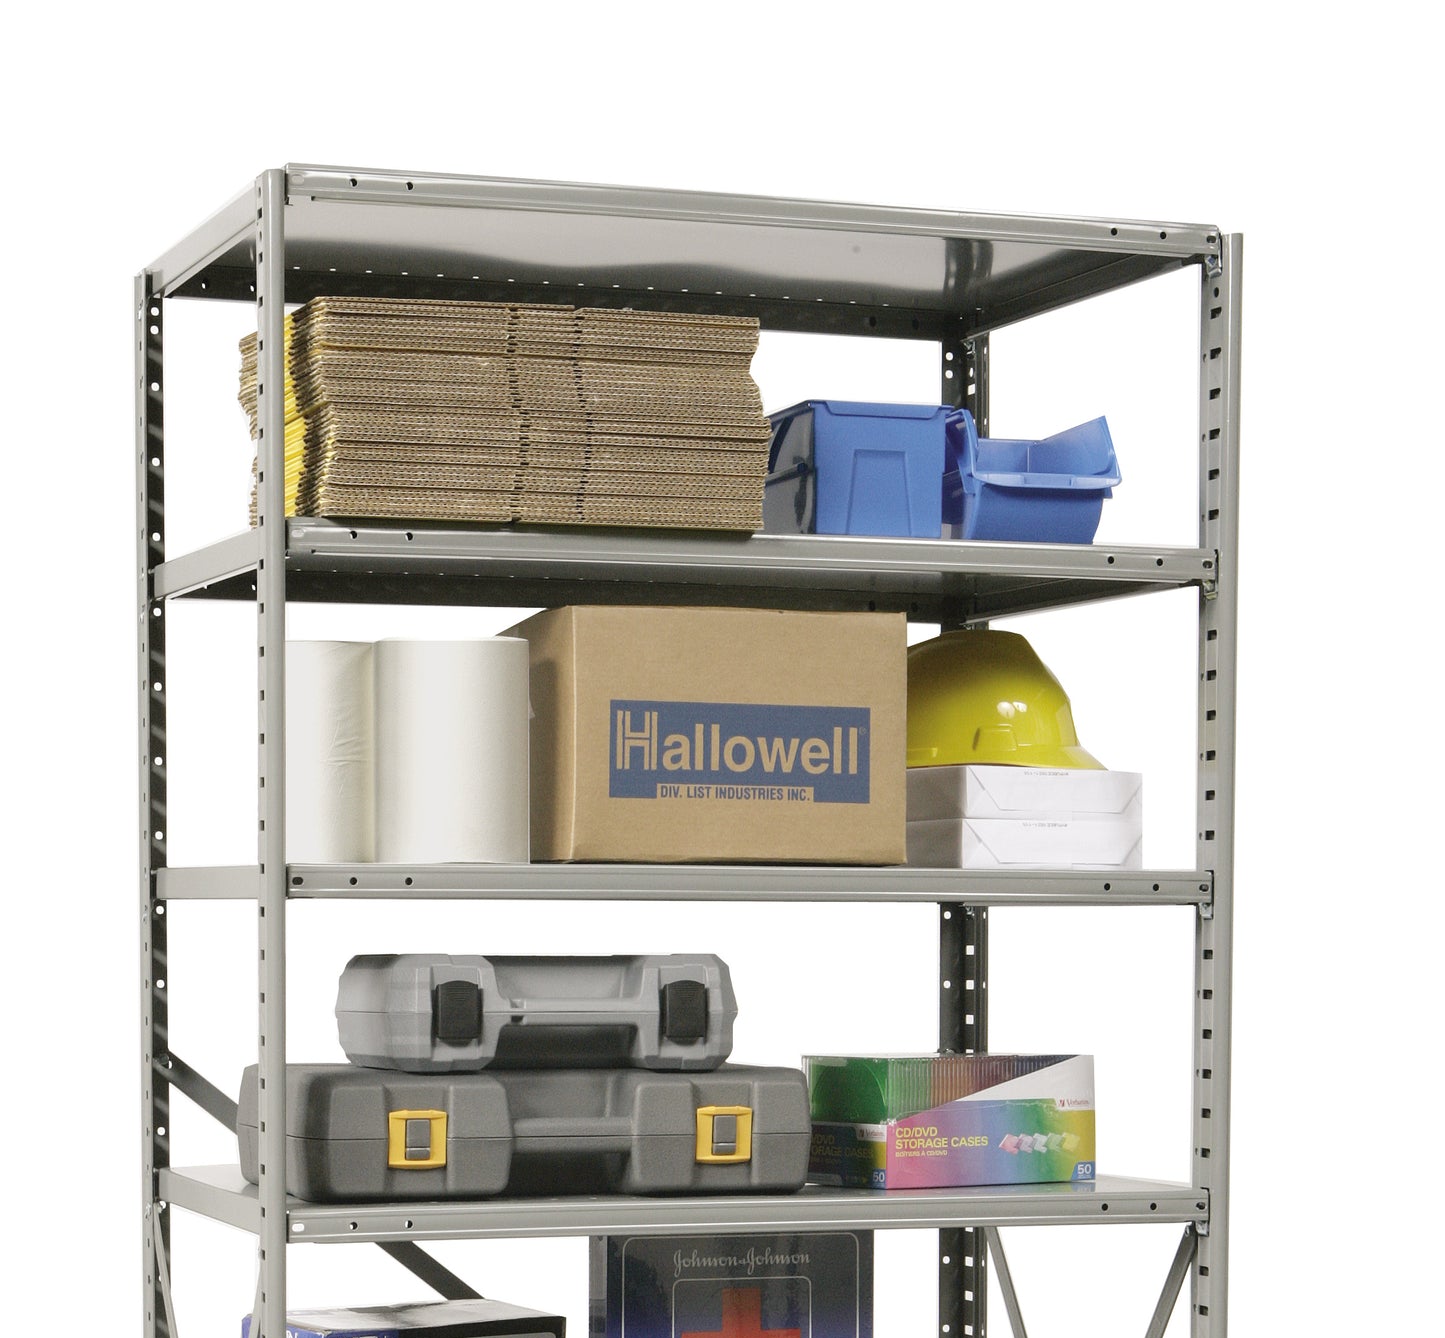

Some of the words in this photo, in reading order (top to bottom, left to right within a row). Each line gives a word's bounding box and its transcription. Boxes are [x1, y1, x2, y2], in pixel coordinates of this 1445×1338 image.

[616, 710, 858, 774] Hallowell
[660, 785, 682, 798] DIV.
[687, 786, 710, 799] LIST
[715, 787, 782, 801] INDUSTRIES
[787, 788, 810, 801] INC.
[895, 1127, 938, 1138] CD/DVD
[895, 1137, 948, 1149] STORAGE
[951, 1136, 988, 1147] CASES
[1077, 1164, 1092, 1174] 50
[872, 1171, 885, 1182] 50
[673, 1249, 737, 1277] Johnson
[747, 1247, 810, 1275] Johnson
